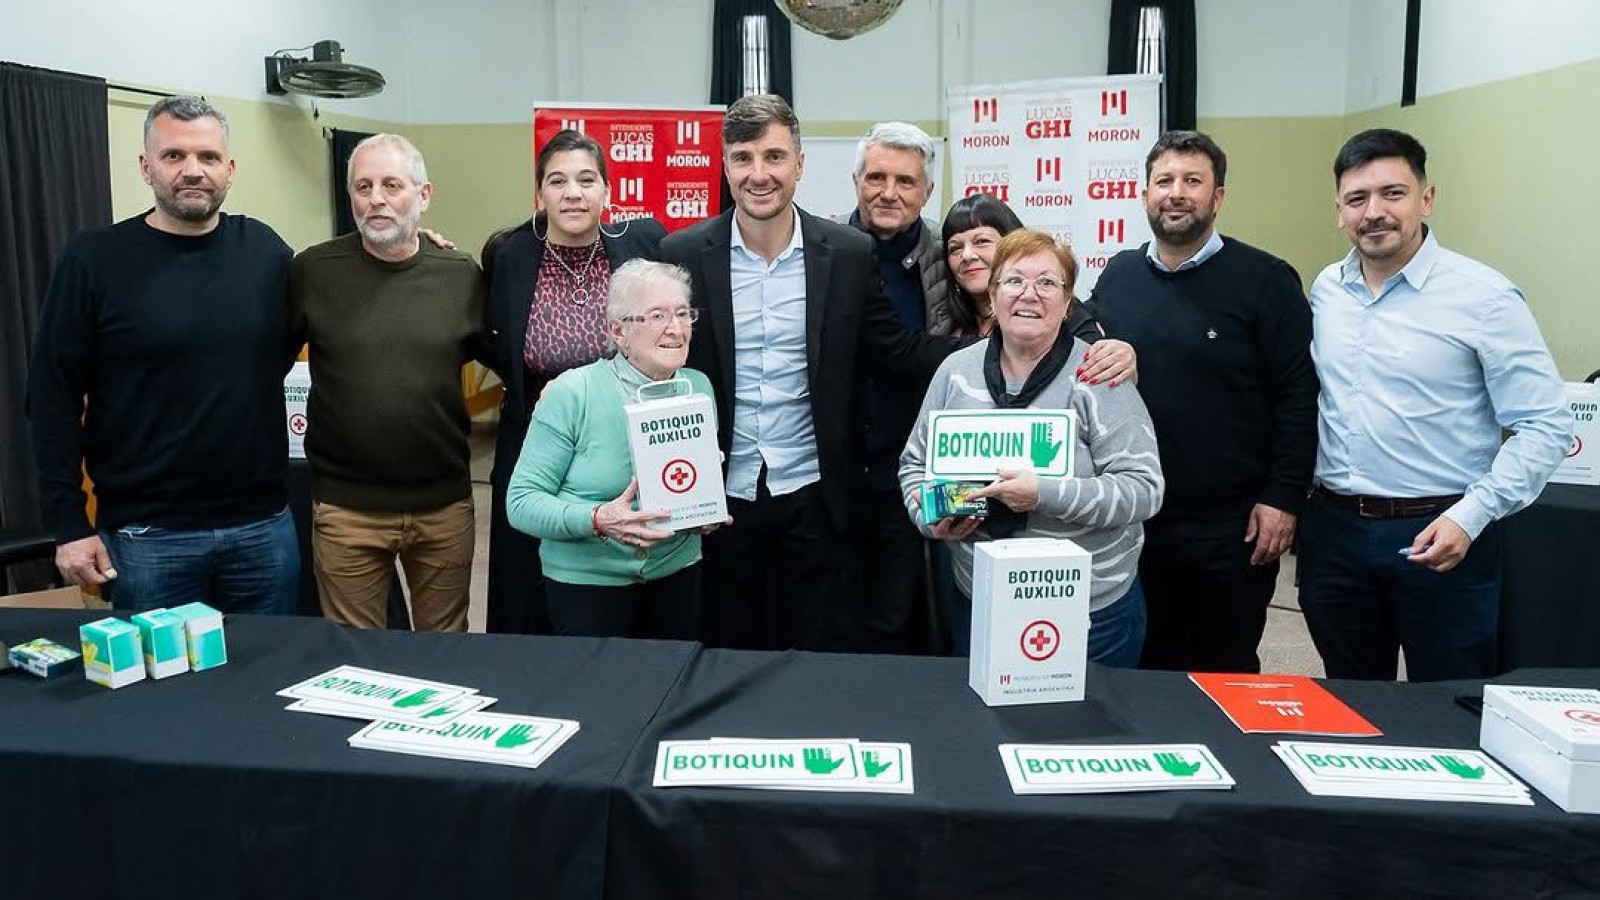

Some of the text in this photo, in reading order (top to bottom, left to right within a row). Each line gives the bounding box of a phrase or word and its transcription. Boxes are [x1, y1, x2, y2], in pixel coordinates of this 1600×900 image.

[1026, 107, 1072, 120] LUCAS
[1026, 120, 1072, 139] GHI
[1088, 129, 1140, 142] MORON
[610, 132, 654, 144] LUCAS
[963, 135, 1010, 148] MORON
[609, 144, 653, 162] GHI
[666, 155, 710, 167] MORON
[965, 172, 1010, 184] LUCAS
[1088, 168, 1139, 180] LUCAS
[667, 189, 709, 201] LUCAS
[1088, 181, 1137, 199] GHI
[1025, 195, 1073, 207] MORON
[666, 201, 709, 218] GHI
[648, 427, 701, 446] AUXILIO
[938, 432, 1025, 458] BOTIQUIN
[1014, 585, 1075, 599] AUXILIO
[313, 677, 408, 700] BOTIQUIN
[673, 754, 795, 769] BOTIQUIN
[1026, 758, 1153, 773] BOTIQUIN
[1306, 754, 1437, 772] BOTIQUIN
